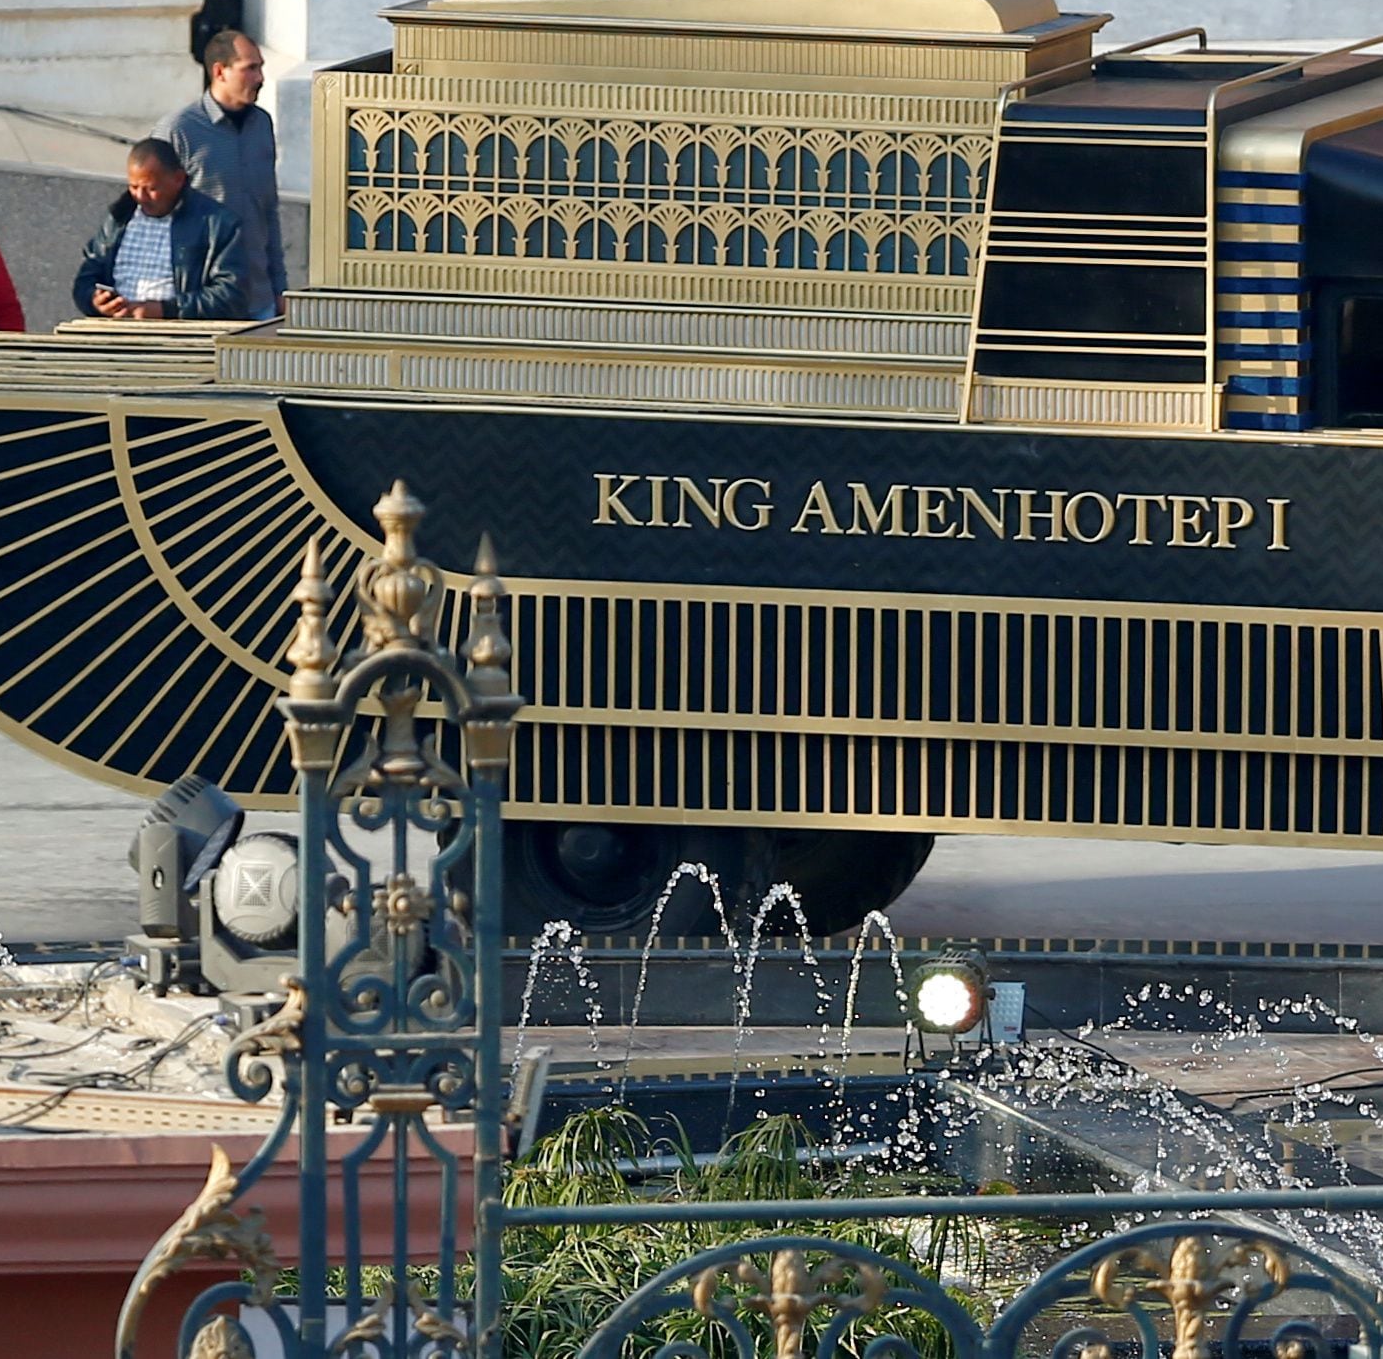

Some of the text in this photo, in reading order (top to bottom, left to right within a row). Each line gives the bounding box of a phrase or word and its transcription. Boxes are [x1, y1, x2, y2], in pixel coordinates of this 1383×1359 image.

[592, 473, 1291, 551] KING AMENHOTEP I
